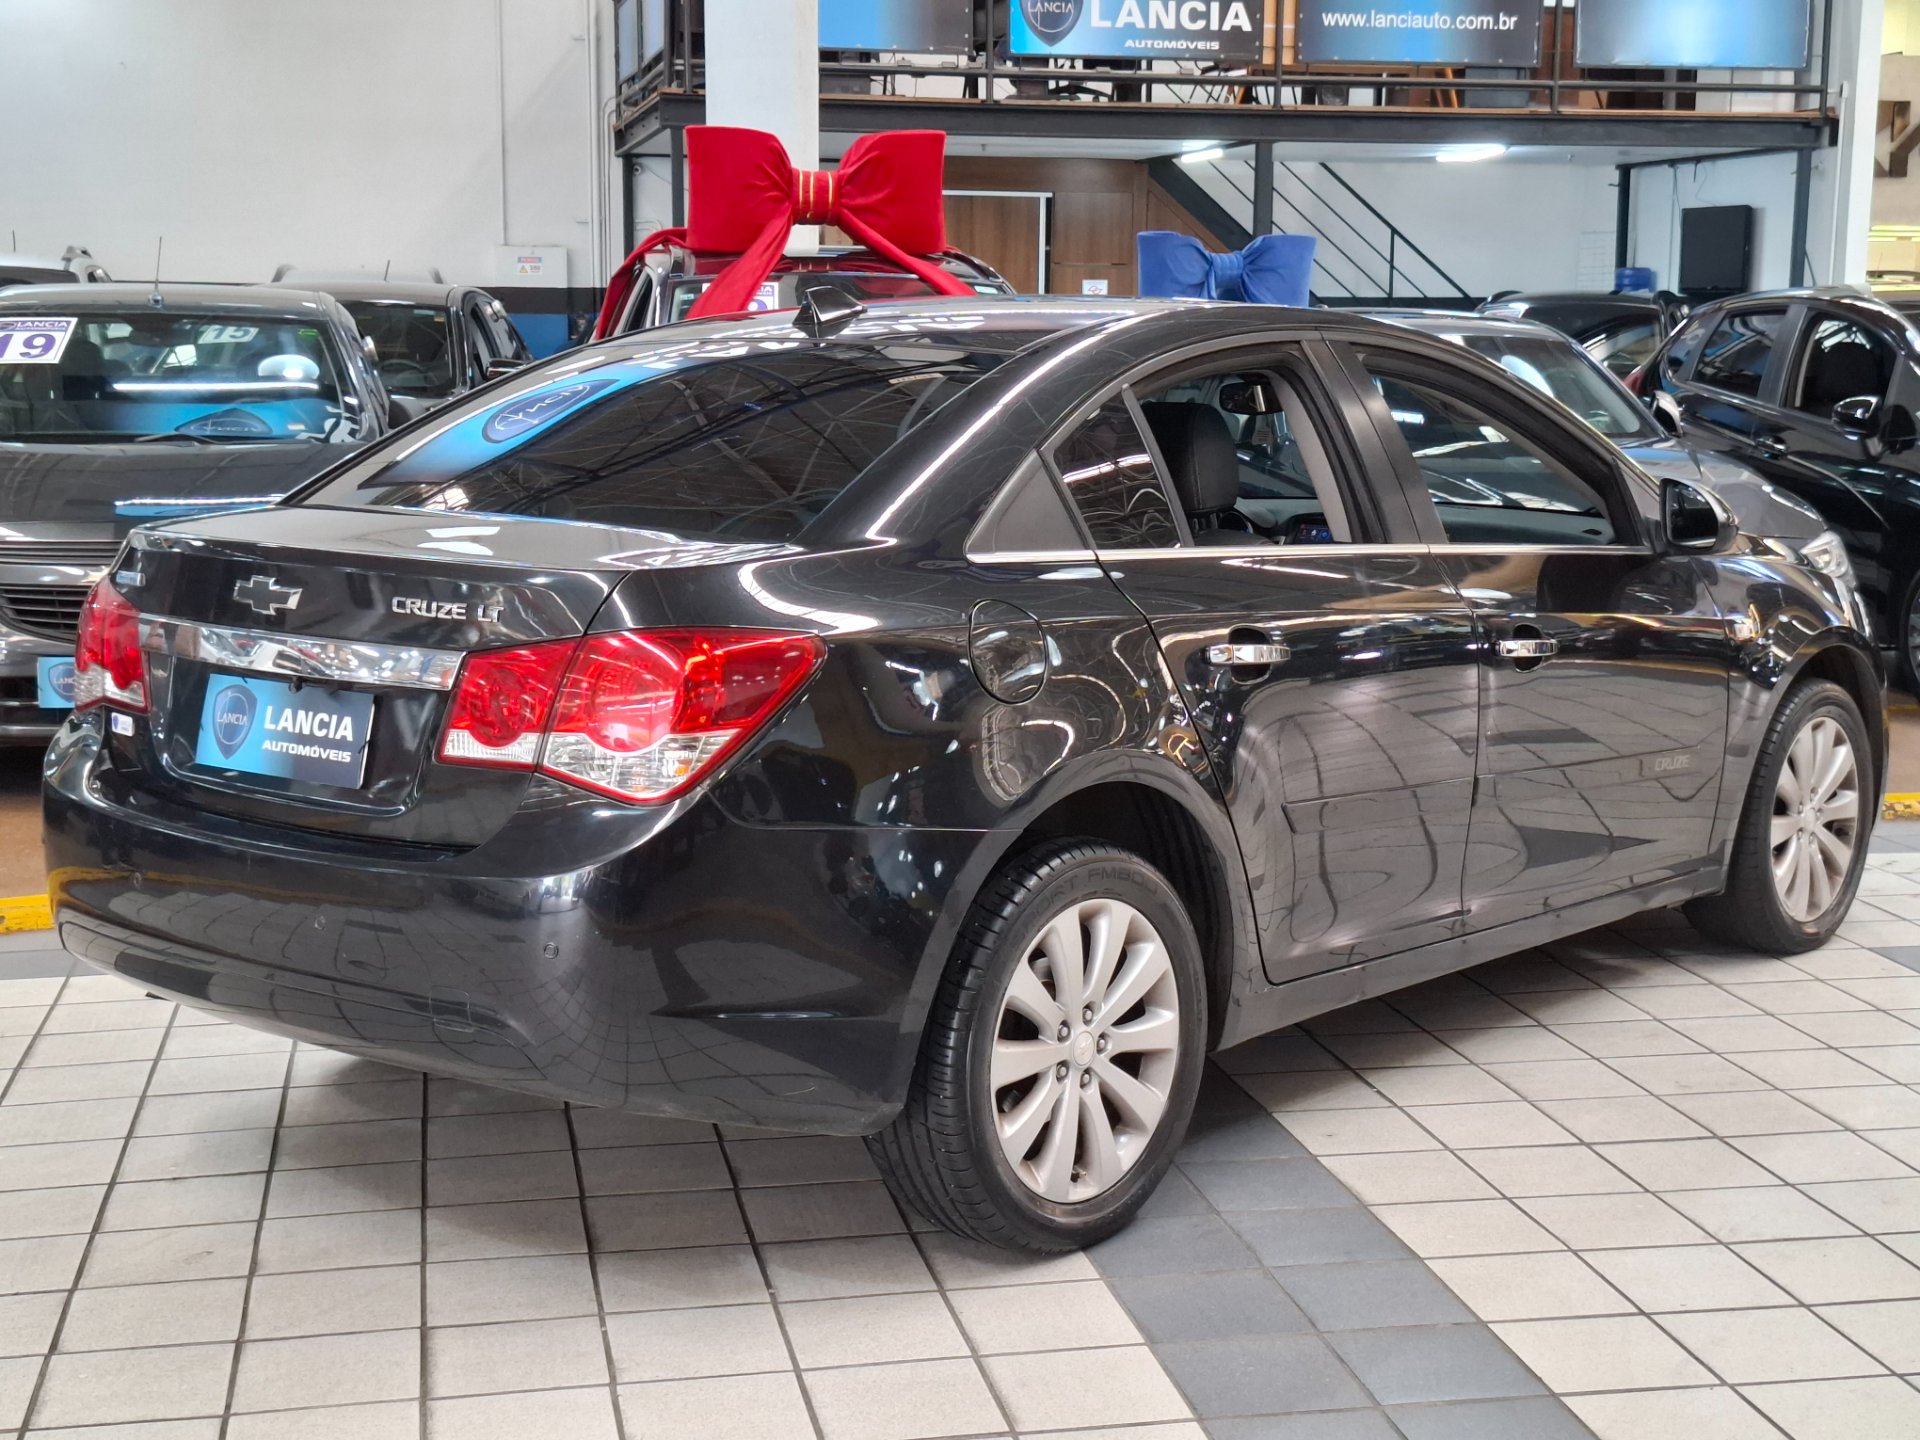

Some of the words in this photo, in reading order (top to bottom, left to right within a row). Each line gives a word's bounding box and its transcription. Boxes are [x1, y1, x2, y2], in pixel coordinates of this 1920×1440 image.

[1028, 1, 1074, 13] LANCIA
[1091, 0, 1253, 32] LANCIA
[1322, 10, 1518, 30] www.lanciauto.com.br
[1124, 38, 1220, 50] AUTOMÓVEIS
[391, 596, 468, 620] CRUZE
[477, 604, 504, 623] LT
[217, 711, 249, 726] LANCIA
[263, 705, 354, 742] LANCIA
[262, 739, 352, 763] AUTOMÓVEIS
[1655, 754, 1690, 771] CRUZE
